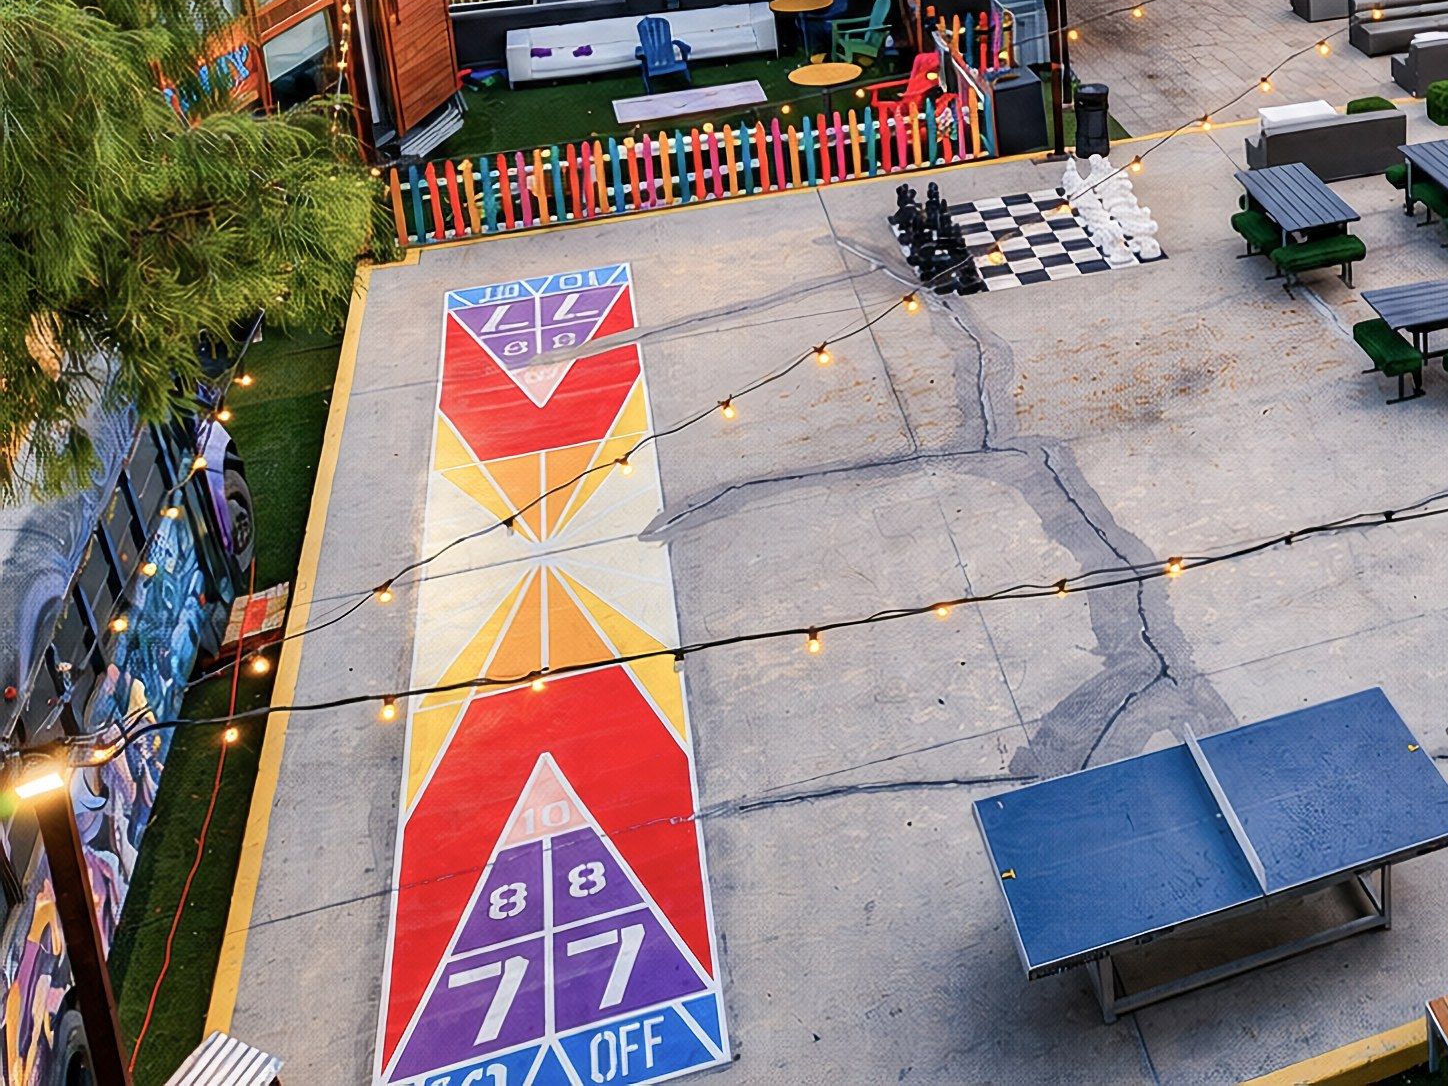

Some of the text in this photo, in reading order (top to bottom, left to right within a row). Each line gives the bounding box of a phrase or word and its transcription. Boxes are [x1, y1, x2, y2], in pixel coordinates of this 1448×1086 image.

[520, 800, 572, 834] 10
[488, 861, 606, 920] 8 8
[448, 923, 646, 1047] 7 7
[589, 1015, 665, 1084] OFF
